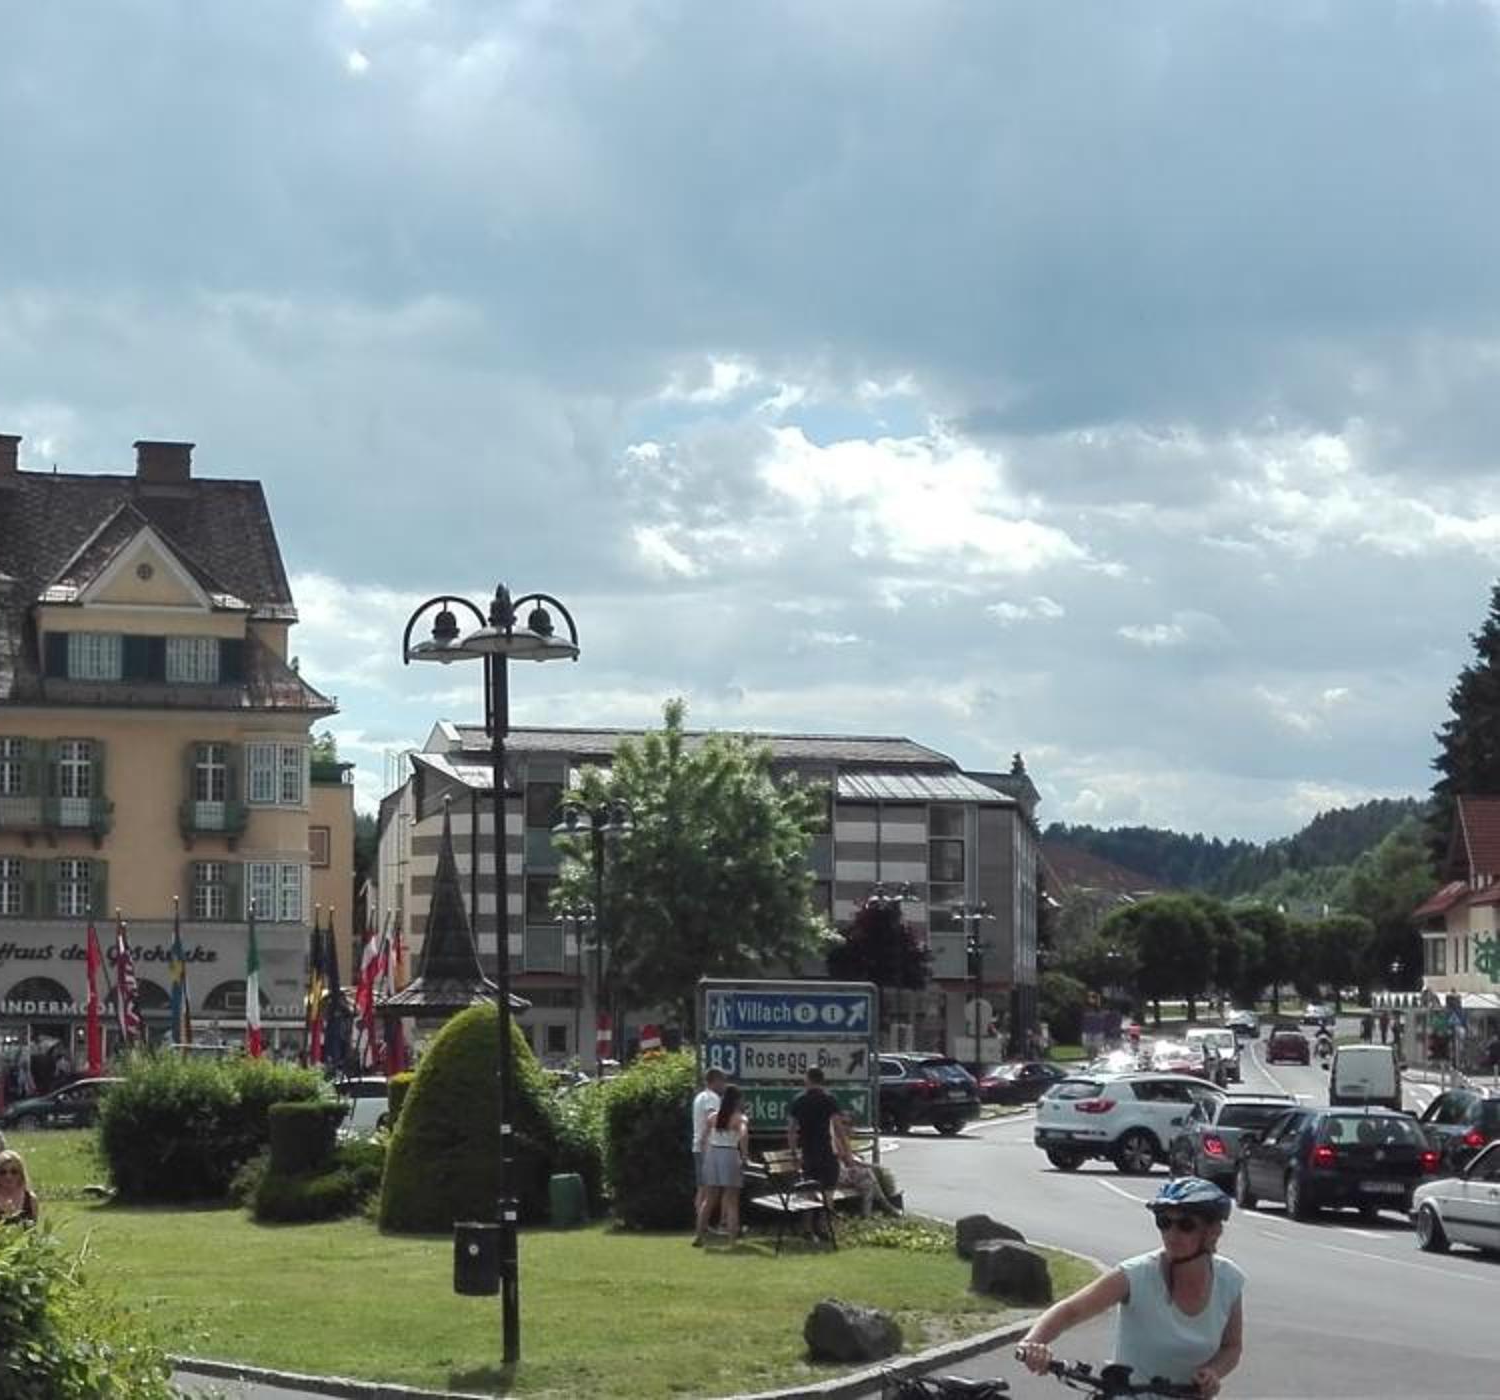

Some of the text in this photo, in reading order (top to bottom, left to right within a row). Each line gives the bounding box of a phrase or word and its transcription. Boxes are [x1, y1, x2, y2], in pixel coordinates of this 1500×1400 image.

[59, 943, 92, 961] de
[737, 1001, 791, 1023] Villach
[710, 1043, 737, 1075] 83
[745, 1048, 807, 1075] Rosegg
[743, 1094, 789, 1121] aker
